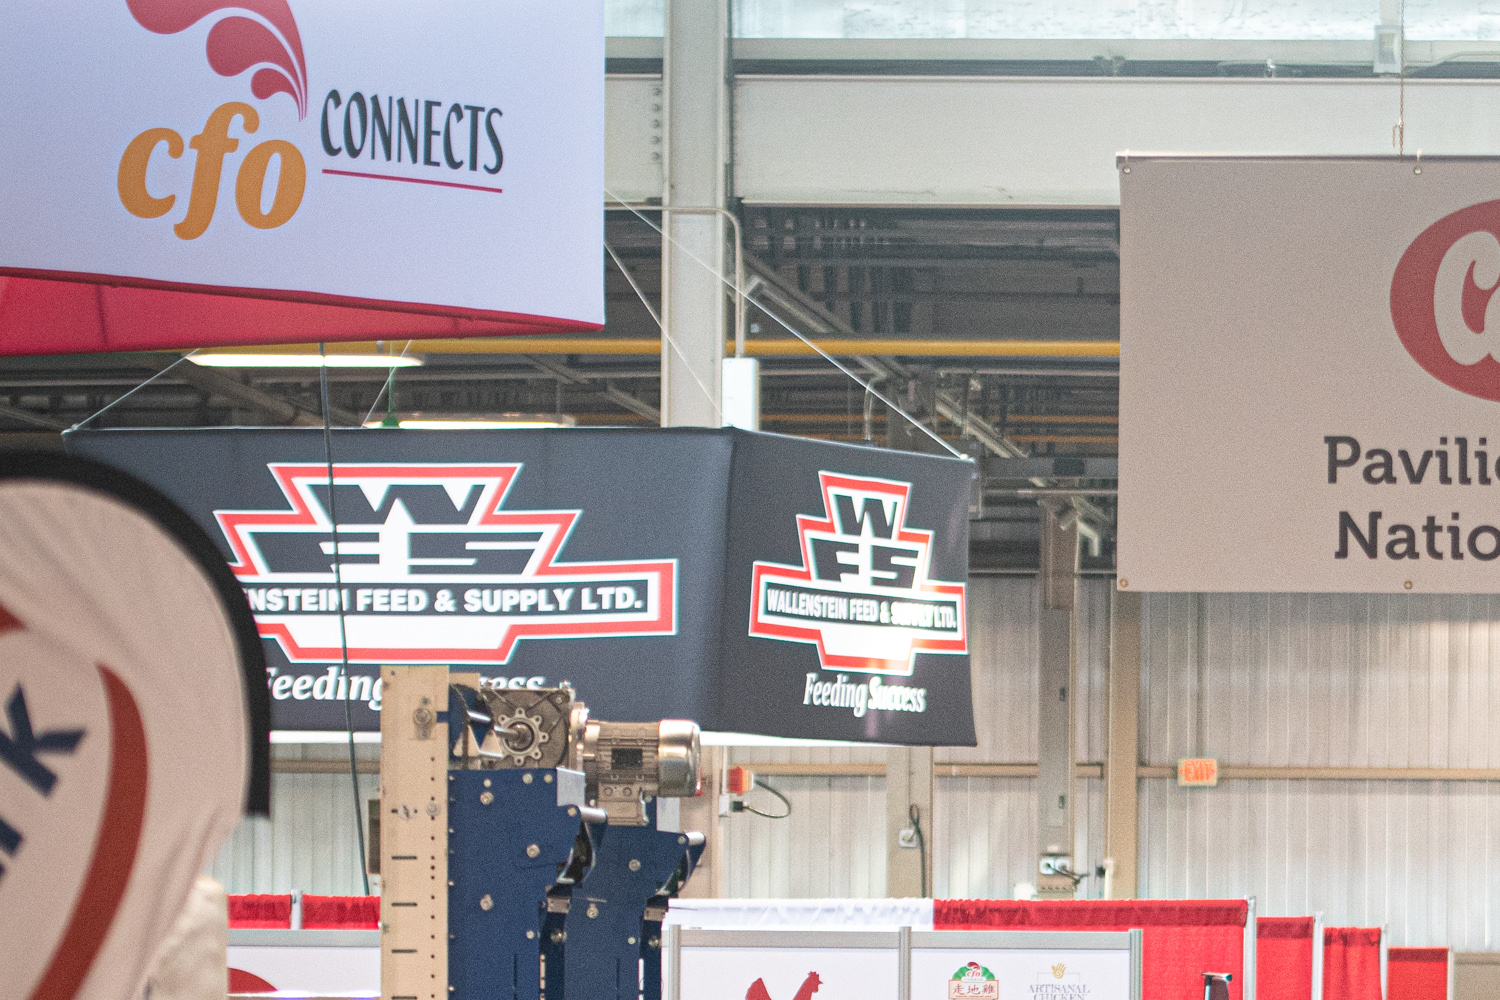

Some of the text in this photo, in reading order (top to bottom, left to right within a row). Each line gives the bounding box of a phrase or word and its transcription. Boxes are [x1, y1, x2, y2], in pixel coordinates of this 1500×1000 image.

[320, 89, 504, 175] CONNECTS
[116, 101, 307, 241] cfo
[244, 586, 642, 612] NSTEIN FEED & SUPPLY LTD.
[767, 588, 848, 620] WALLENSTEIN
[849, 598, 879, 622] FEED
[880, 603, 890, 623] &
[935, 604, 957, 629] LTD.
[803, 672, 927, 718] Feeding Success
[1184, 760, 1211, 782] EXIT
[1028, 984, 1090, 994] ARTISANAL
